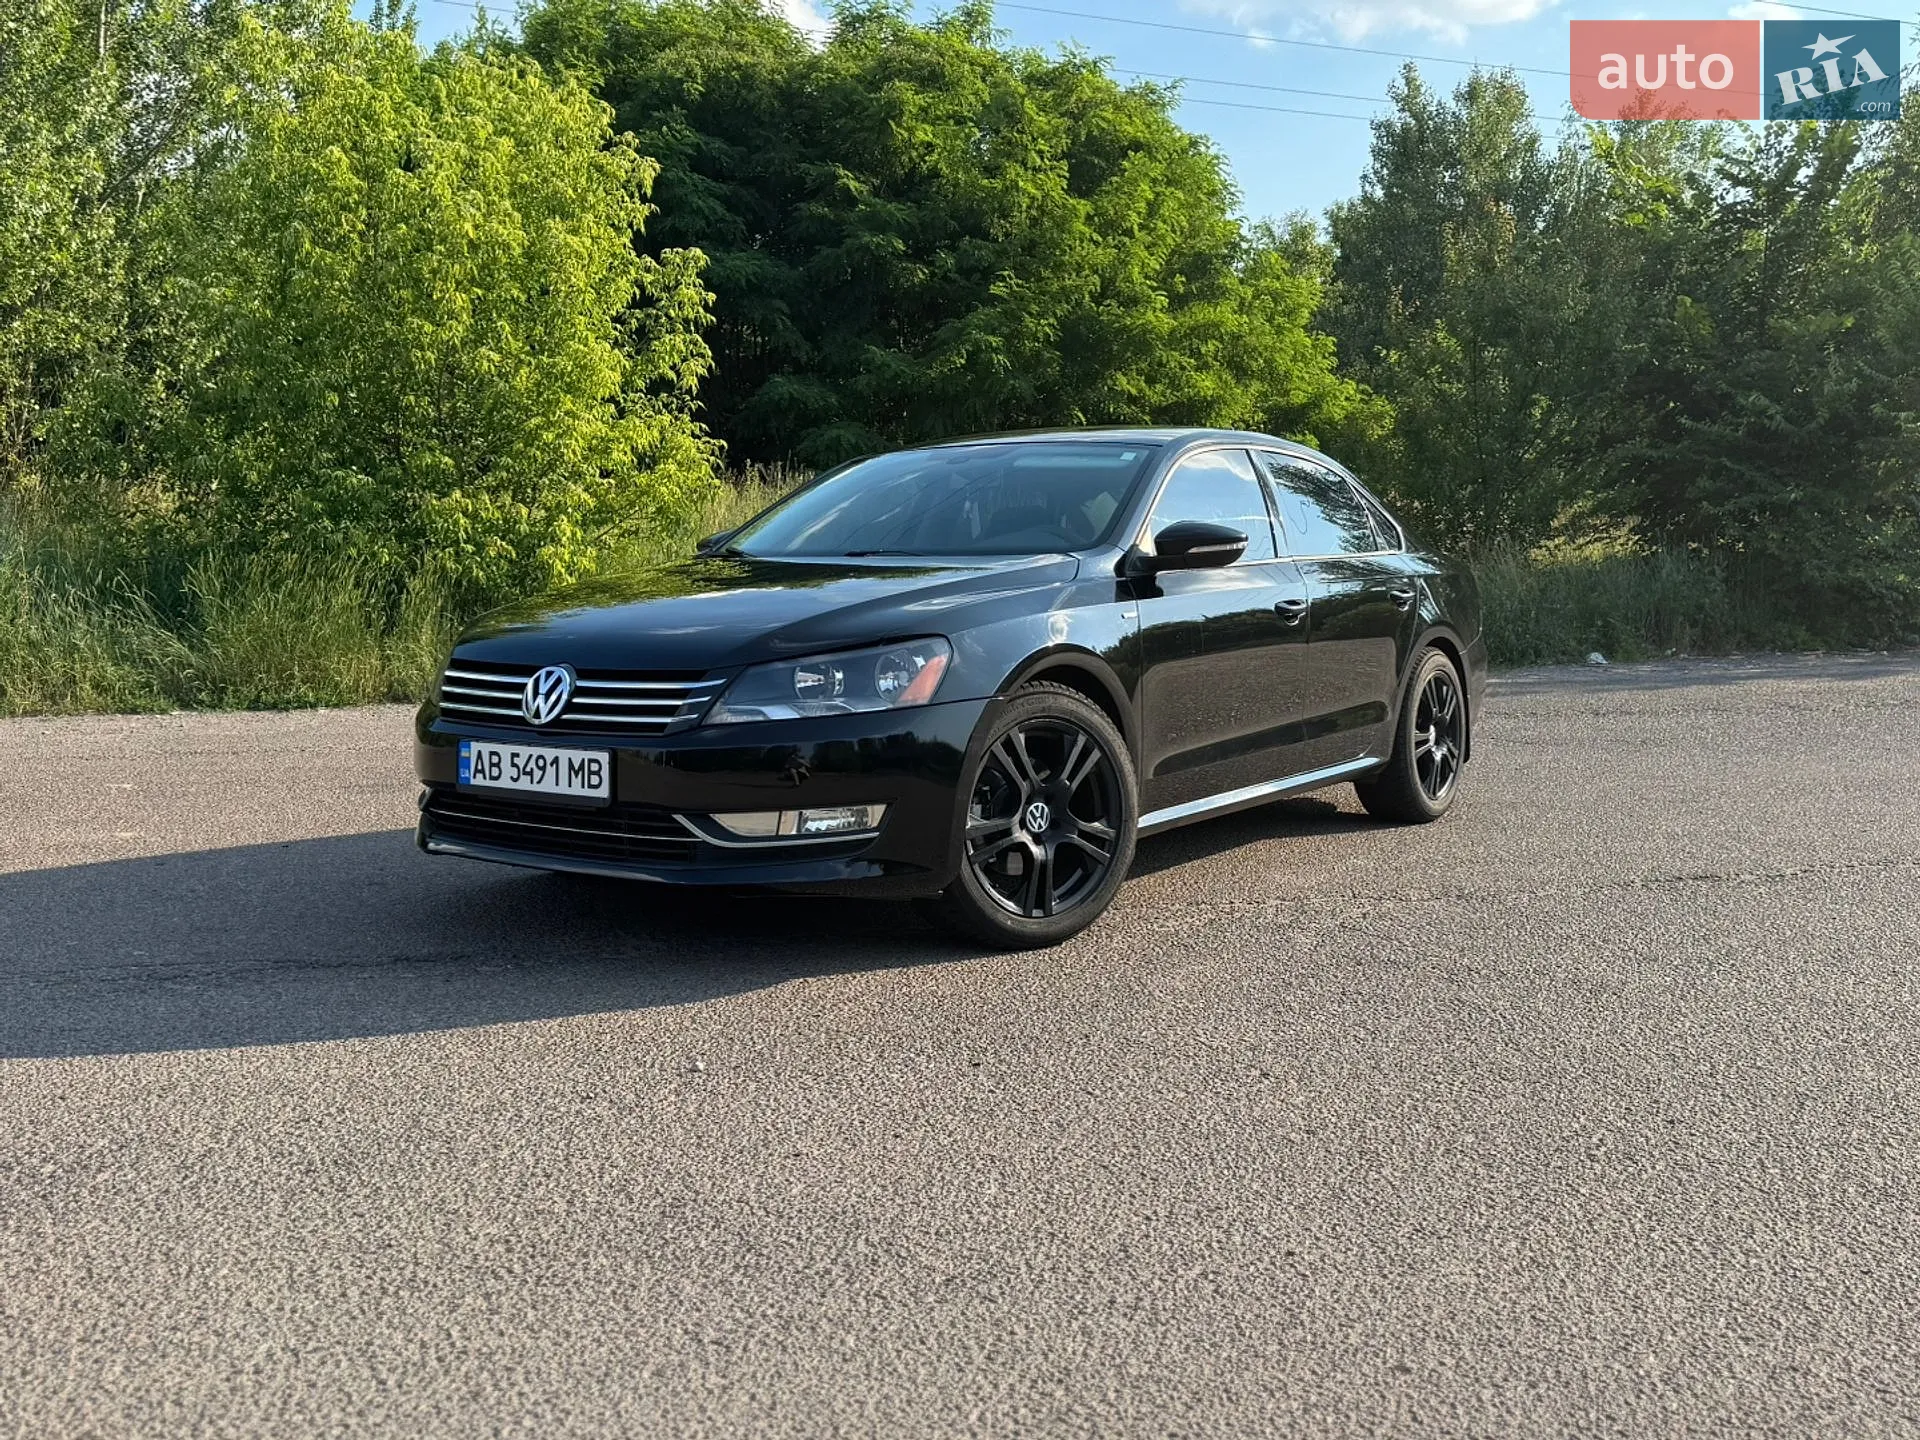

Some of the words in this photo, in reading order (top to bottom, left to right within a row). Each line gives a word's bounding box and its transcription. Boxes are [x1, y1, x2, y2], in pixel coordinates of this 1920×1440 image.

[473, 750, 502, 781] AB
[510, 752, 559, 787] 5491
[568, 757, 602, 789] MB
